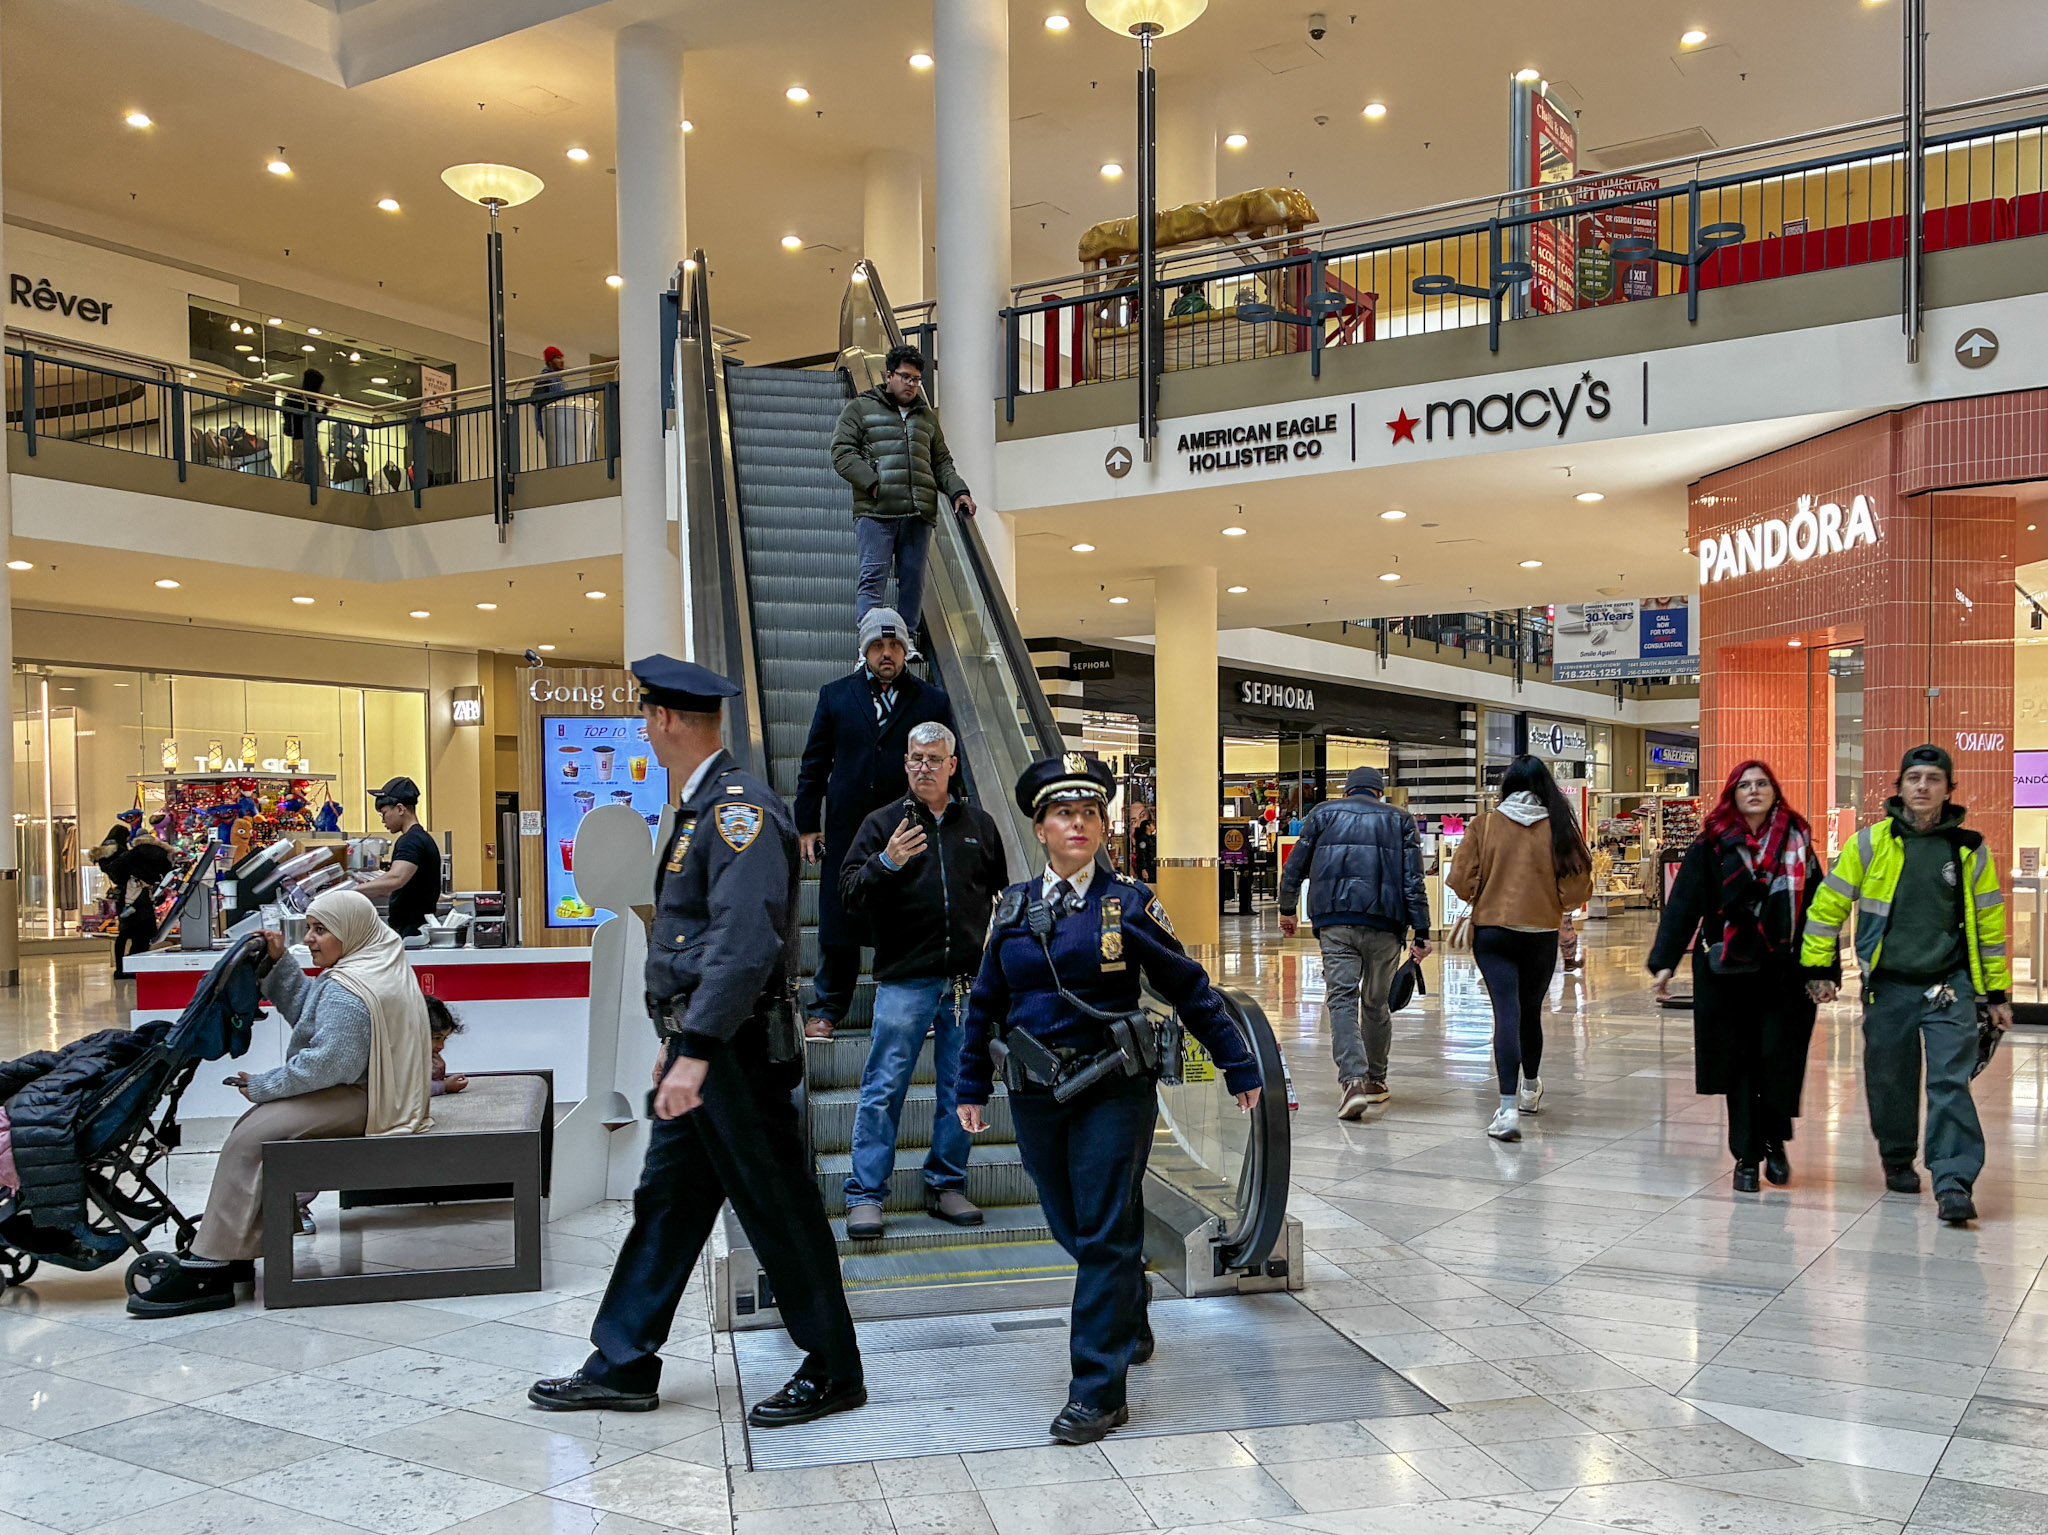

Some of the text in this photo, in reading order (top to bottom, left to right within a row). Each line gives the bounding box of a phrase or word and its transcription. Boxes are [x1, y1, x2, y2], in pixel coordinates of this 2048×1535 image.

[1605, 214, 1637, 225] CRSSROAS
[10, 273, 113, 325] Rêver
[1426, 370, 1611, 440] macy's
[1177, 413, 1337, 451] AMERICAN EAGLE
[1189, 443, 1288, 472] HOLLISTER
[1699, 494, 1878, 585] PANDORA
[1585, 611, 1634, 622] 30 Years
[1662, 627, 1676, 635] YOUR
[1597, 649, 1617, 657] Again!
[1072, 660, 1110, 671] SEPHORA
[1559, 668, 1622, 679] 718.226.1251
[529, 679, 641, 710] Gong ch
[1241, 680, 1315, 711] SEPHORA
[584, 727, 627, 737] TOP 10
[1662, 748, 1695, 763] SKECHERS
